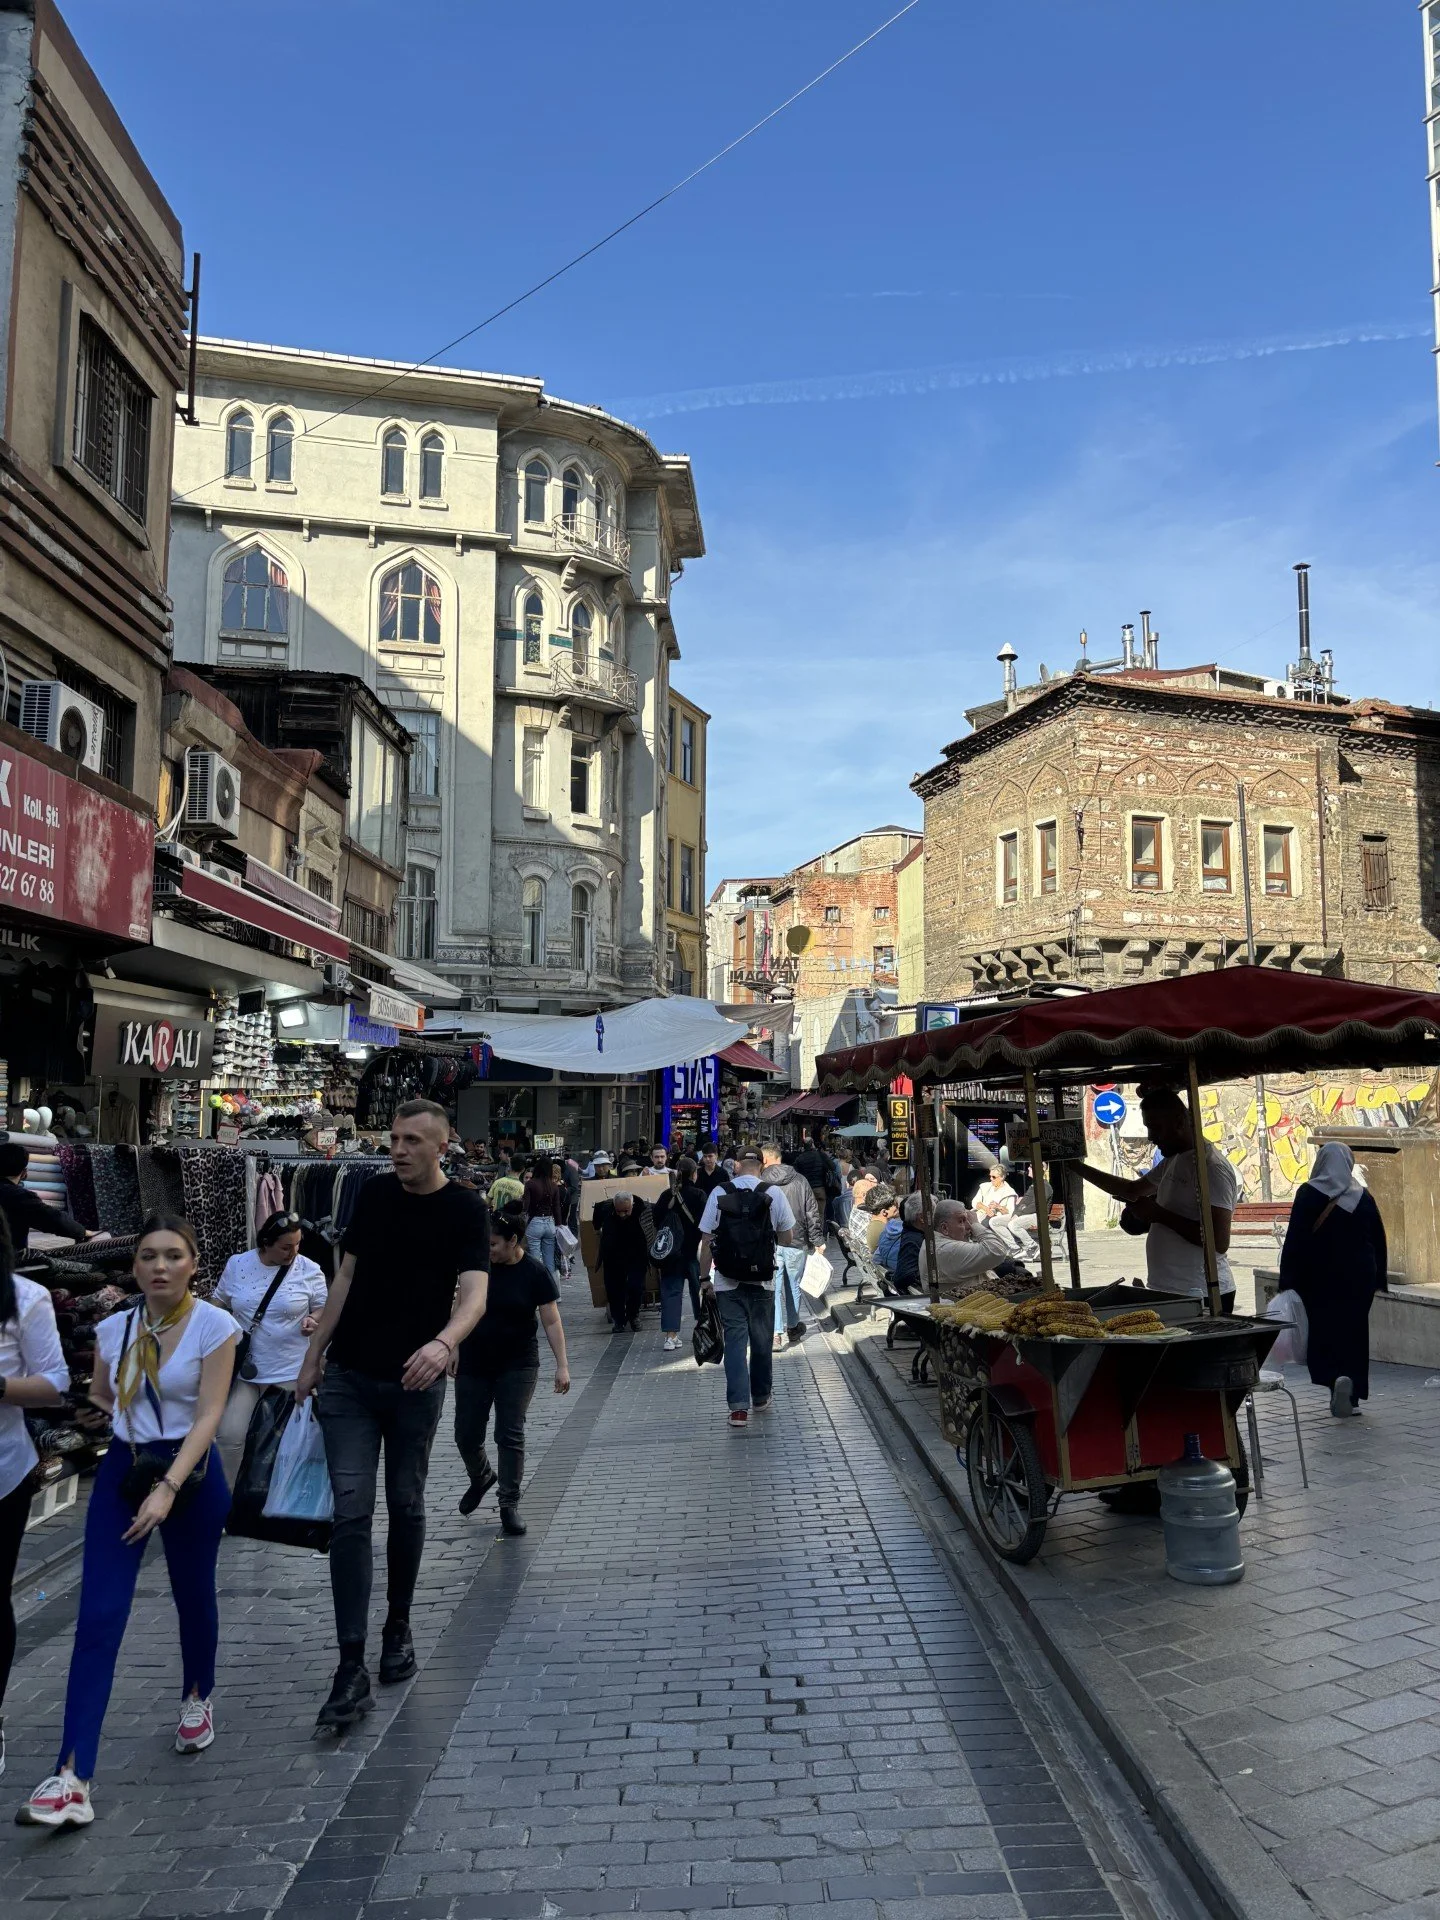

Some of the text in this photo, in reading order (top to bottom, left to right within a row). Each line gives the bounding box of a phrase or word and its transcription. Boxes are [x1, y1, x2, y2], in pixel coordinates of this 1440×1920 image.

[24, 794, 43, 821] Koll.
[0, 828, 55, 869] NLERİ
[21, 872, 37, 898] 67
[40, 879, 54, 903] 88
[123, 1021, 201, 1068] KARALI
[674, 1058, 714, 1098] STAR
[701, 1109, 709, 1133] WEAR
